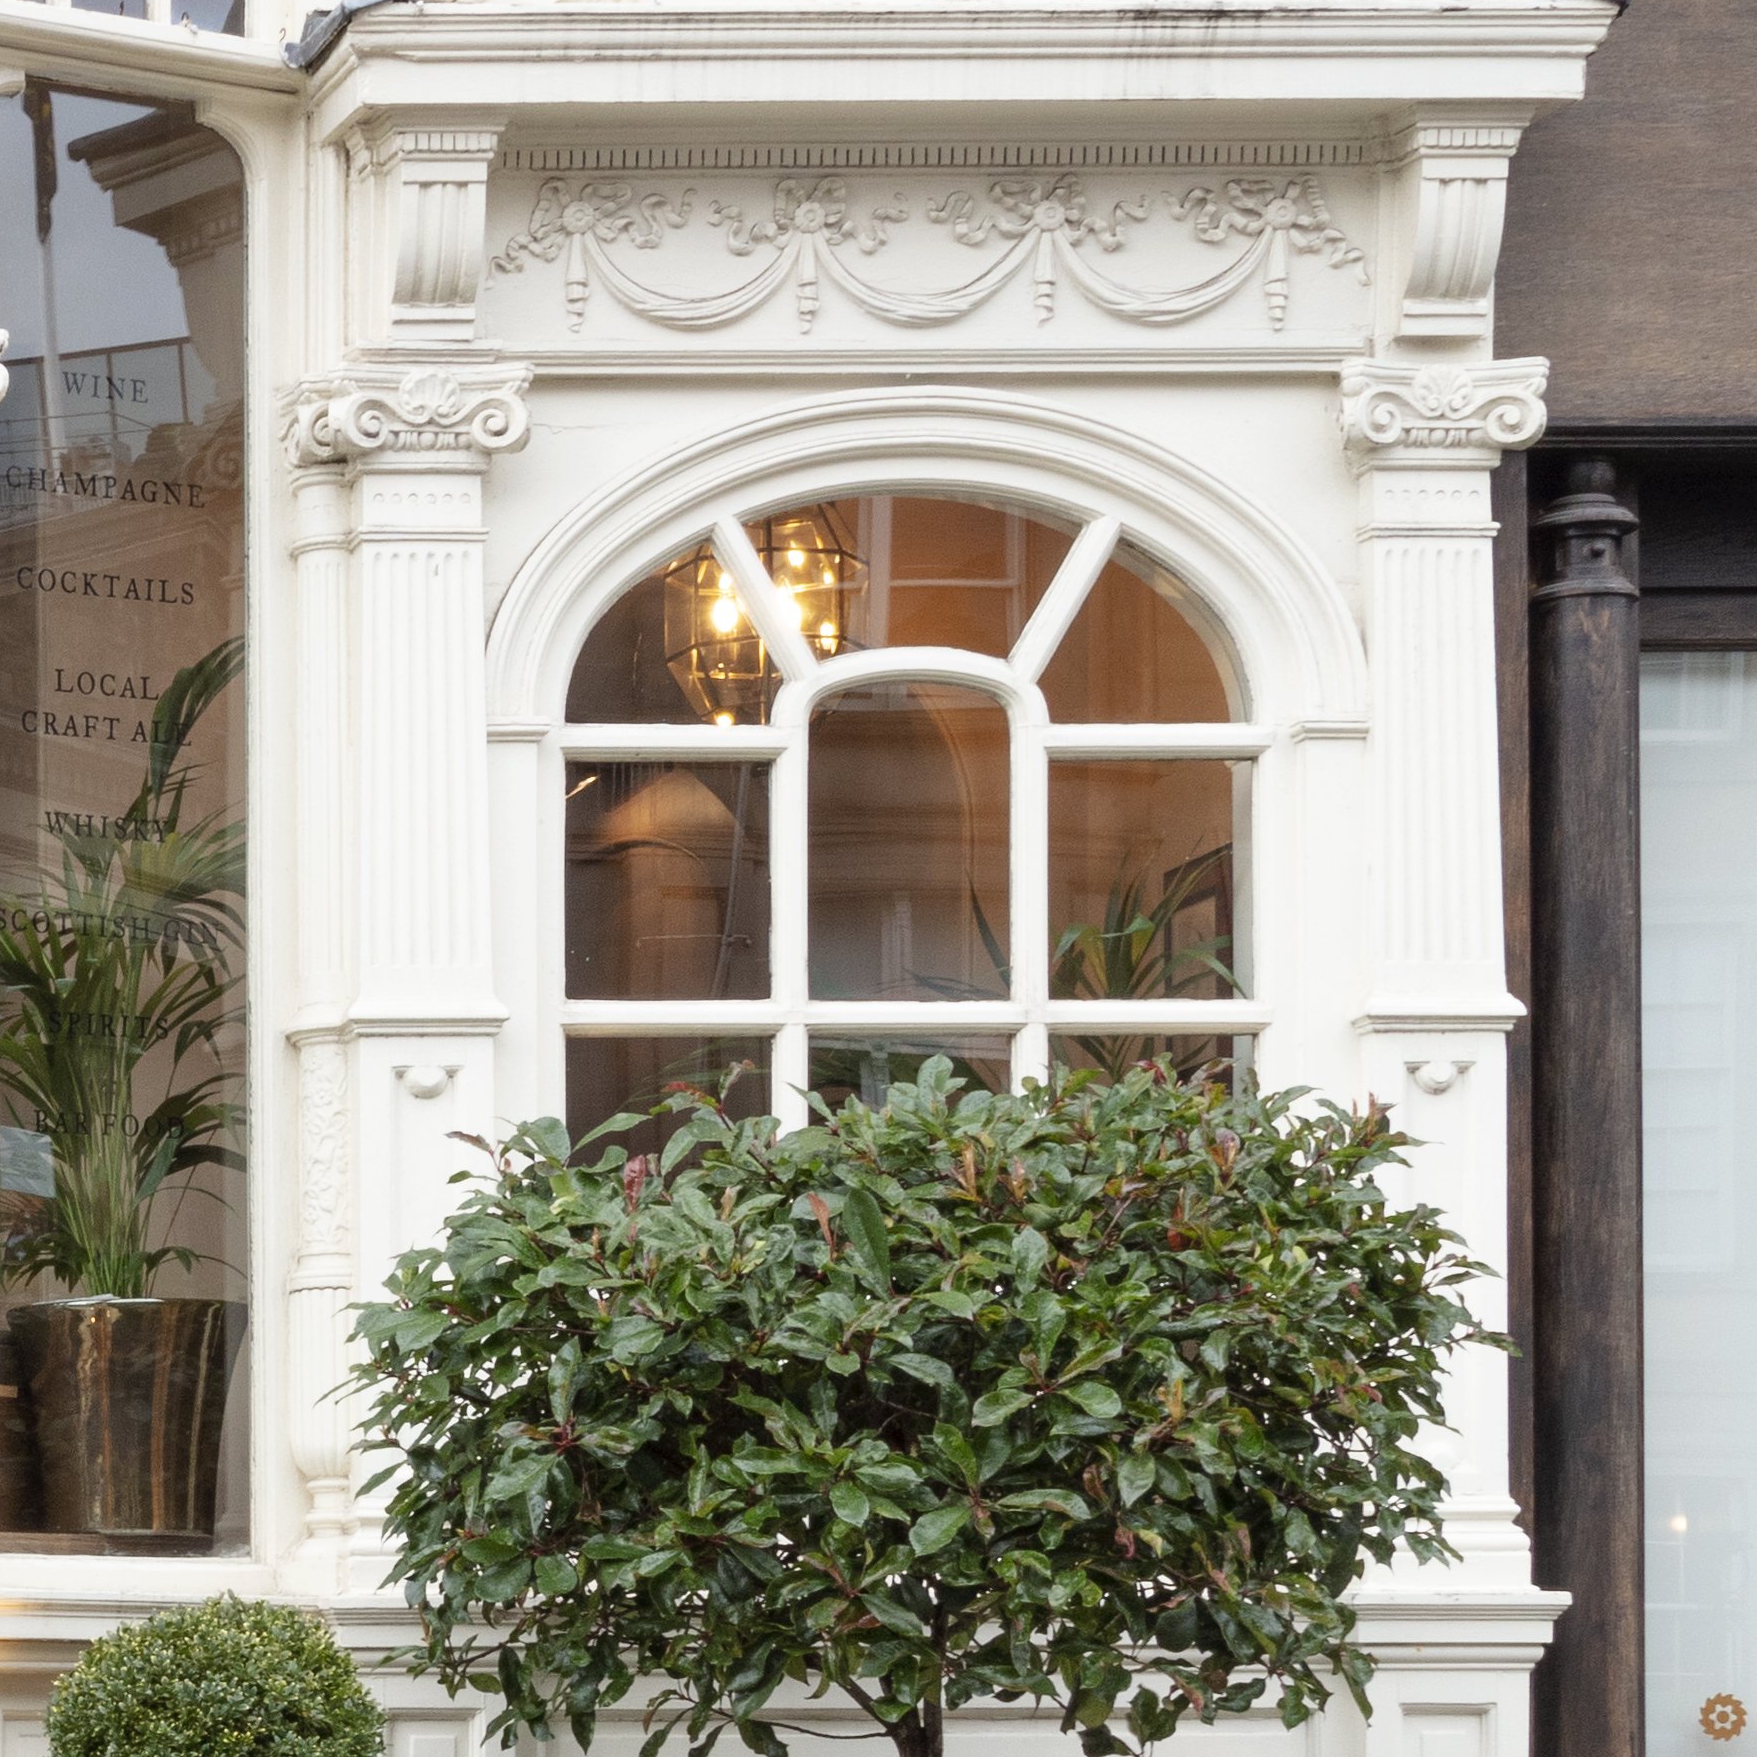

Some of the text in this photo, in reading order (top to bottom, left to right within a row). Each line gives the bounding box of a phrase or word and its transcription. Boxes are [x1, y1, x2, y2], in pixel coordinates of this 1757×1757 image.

[64, 372, 149, 403] WINE
[6, 465, 205, 508] CHAMPAGNE
[17, 566, 194, 604] COCKTAILS
[55, 668, 159, 700] LOCAL
[21, 711, 191, 746] CRAFT ALE
[45, 811, 169, 843] WHISKY
[163, 918, 221, 946] GIN
[50, 1010, 169, 1040] SPIRITS
[34, 1110, 185, 1139] BAR FOOD
